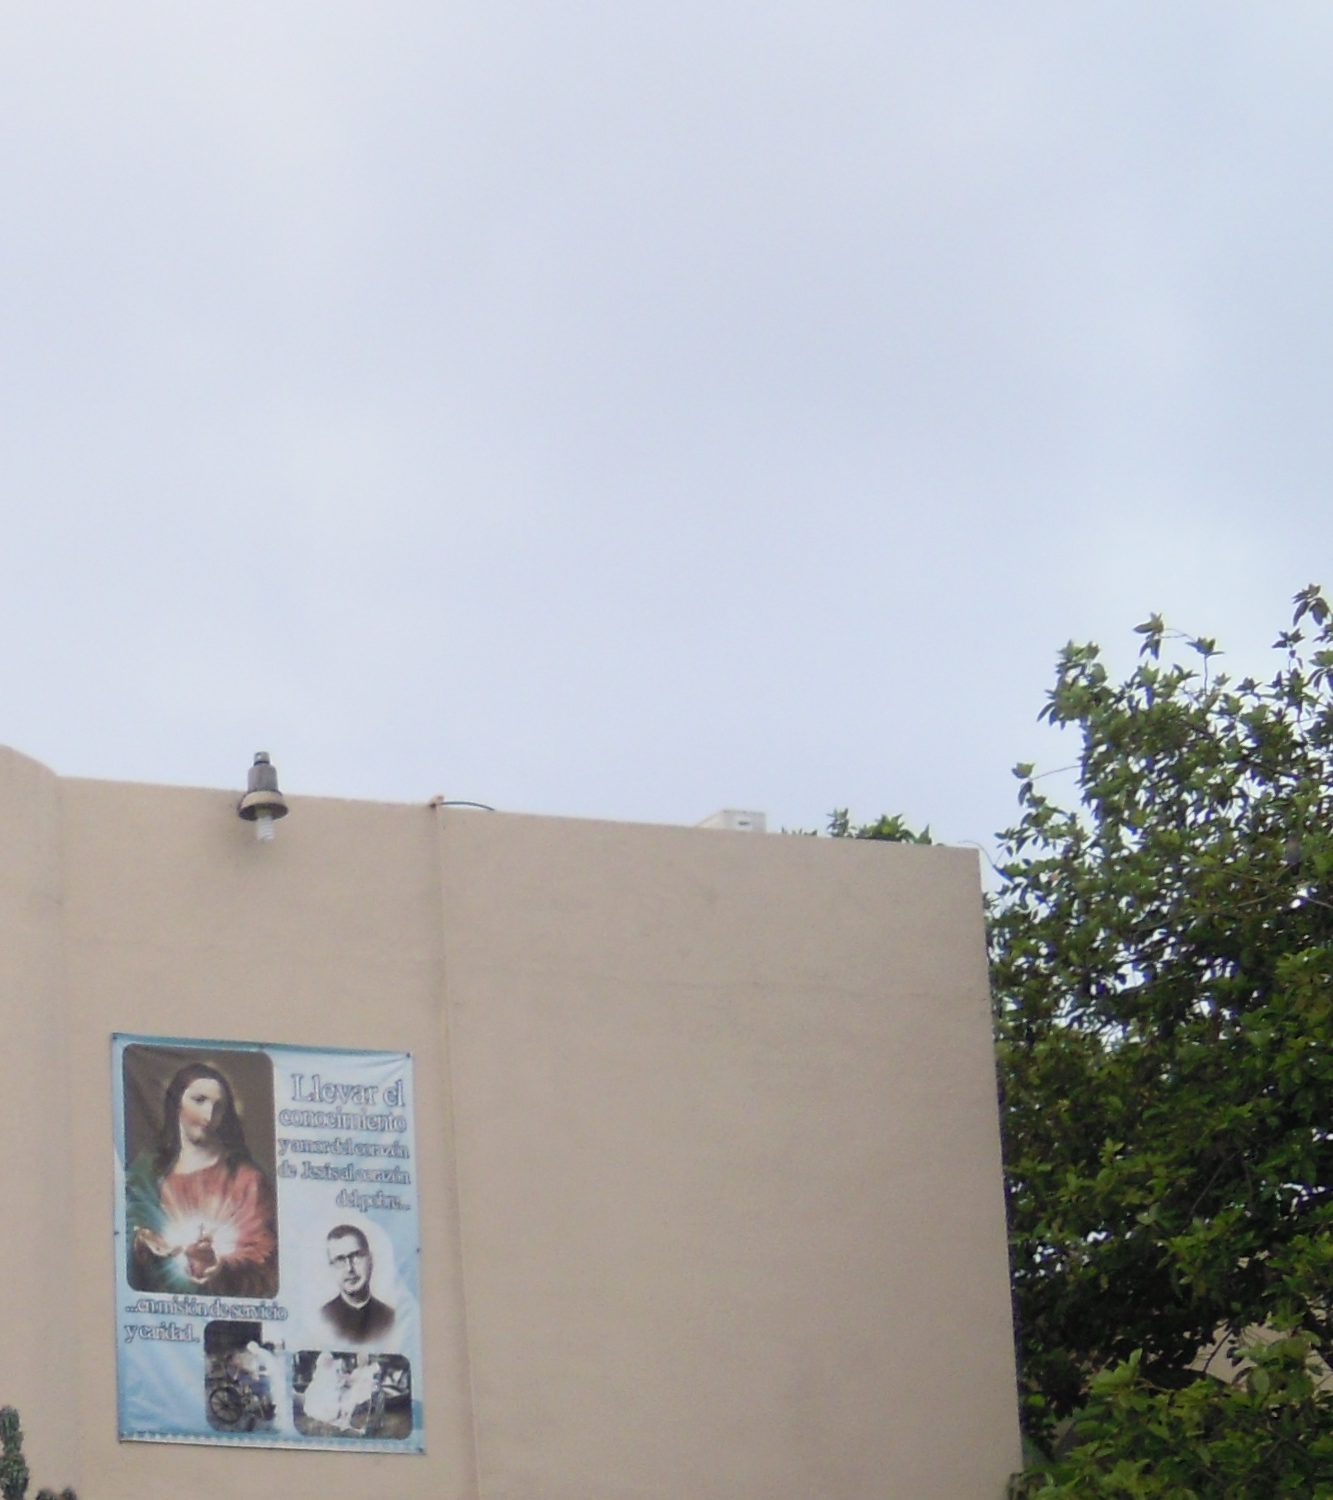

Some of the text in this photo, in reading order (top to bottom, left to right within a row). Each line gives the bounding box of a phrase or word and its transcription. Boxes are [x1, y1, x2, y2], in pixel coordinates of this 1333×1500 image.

[290, 1073, 406, 1107] Llevar el
[278, 1106, 408, 1134] conocimiento
[158, 1295, 207, 1317] misión
[209, 1297, 230, 1319] de
[230, 1300, 289, 1321] servicio
[124, 1324, 138, 1343] y
